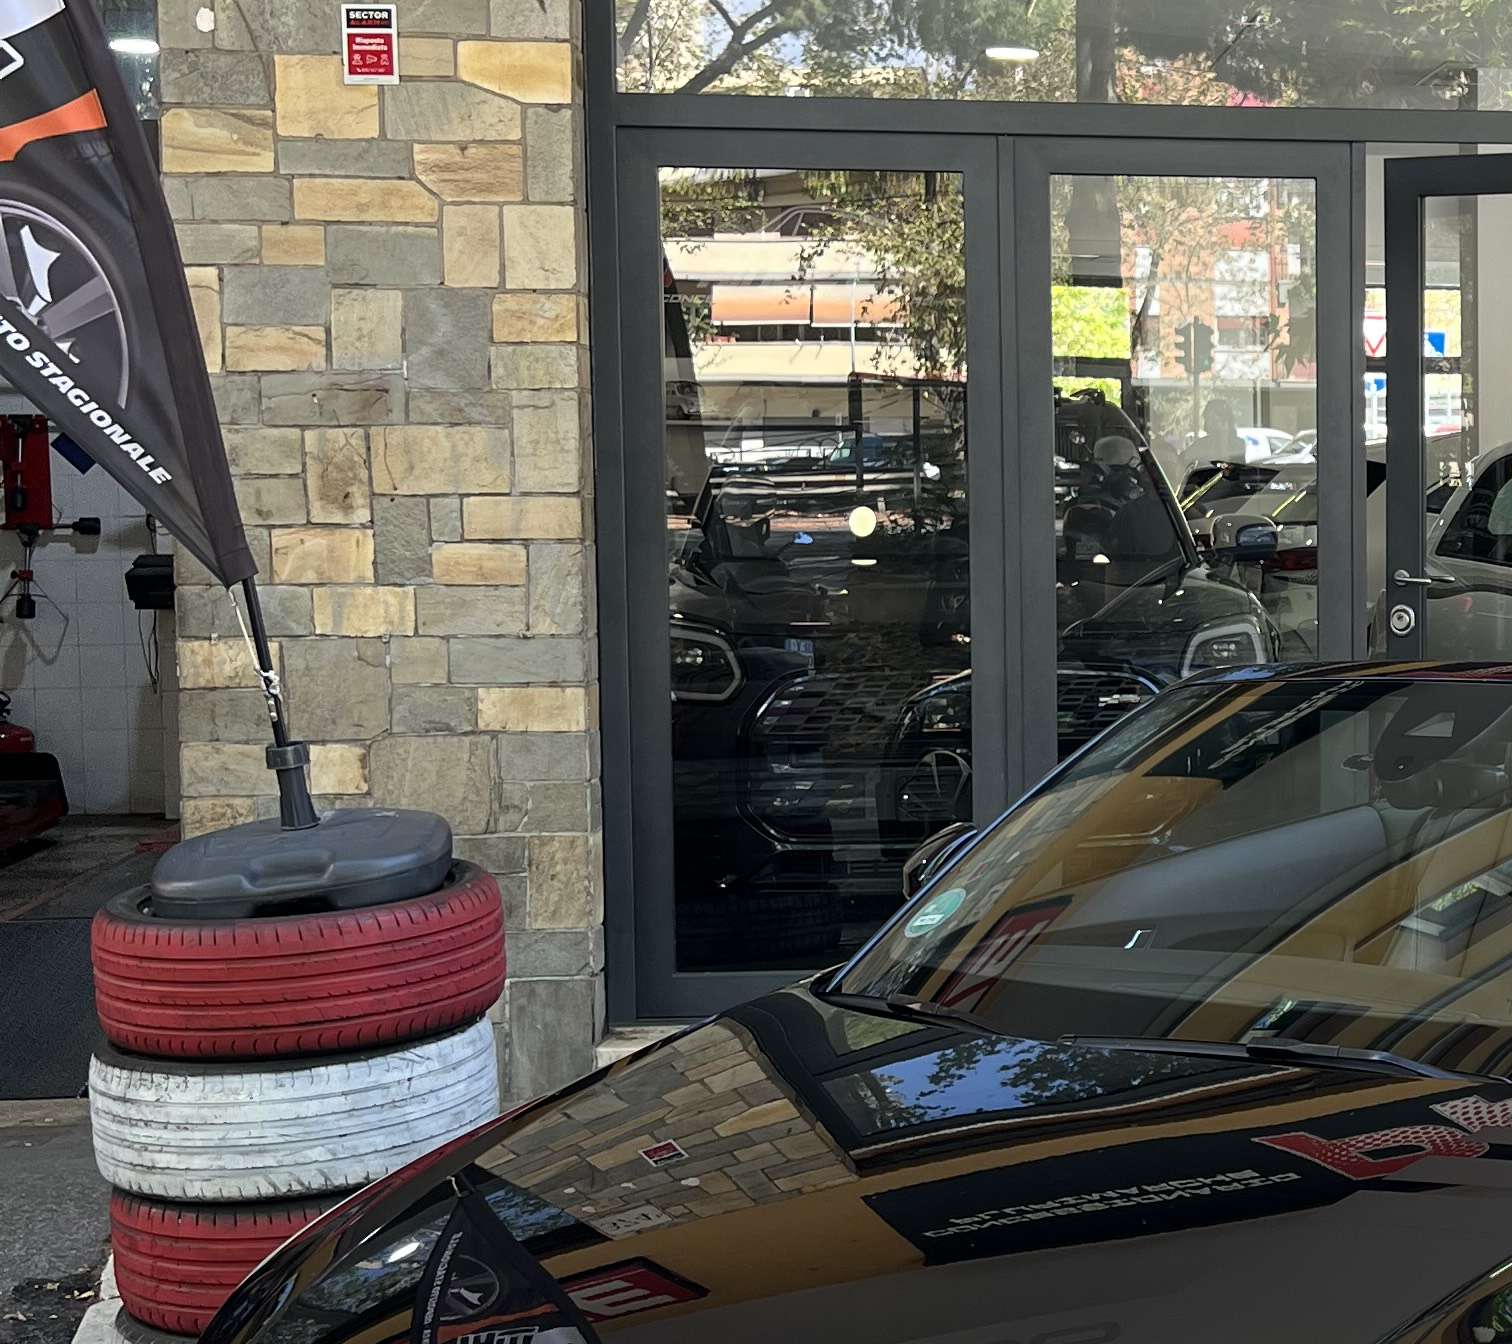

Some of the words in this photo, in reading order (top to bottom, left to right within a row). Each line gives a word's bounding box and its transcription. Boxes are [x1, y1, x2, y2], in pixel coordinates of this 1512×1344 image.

[349, 11, 389, 19] SECTOR
[0, 315, 31, 352] TO
[25, 350, 173, 486] STAGIONALE
